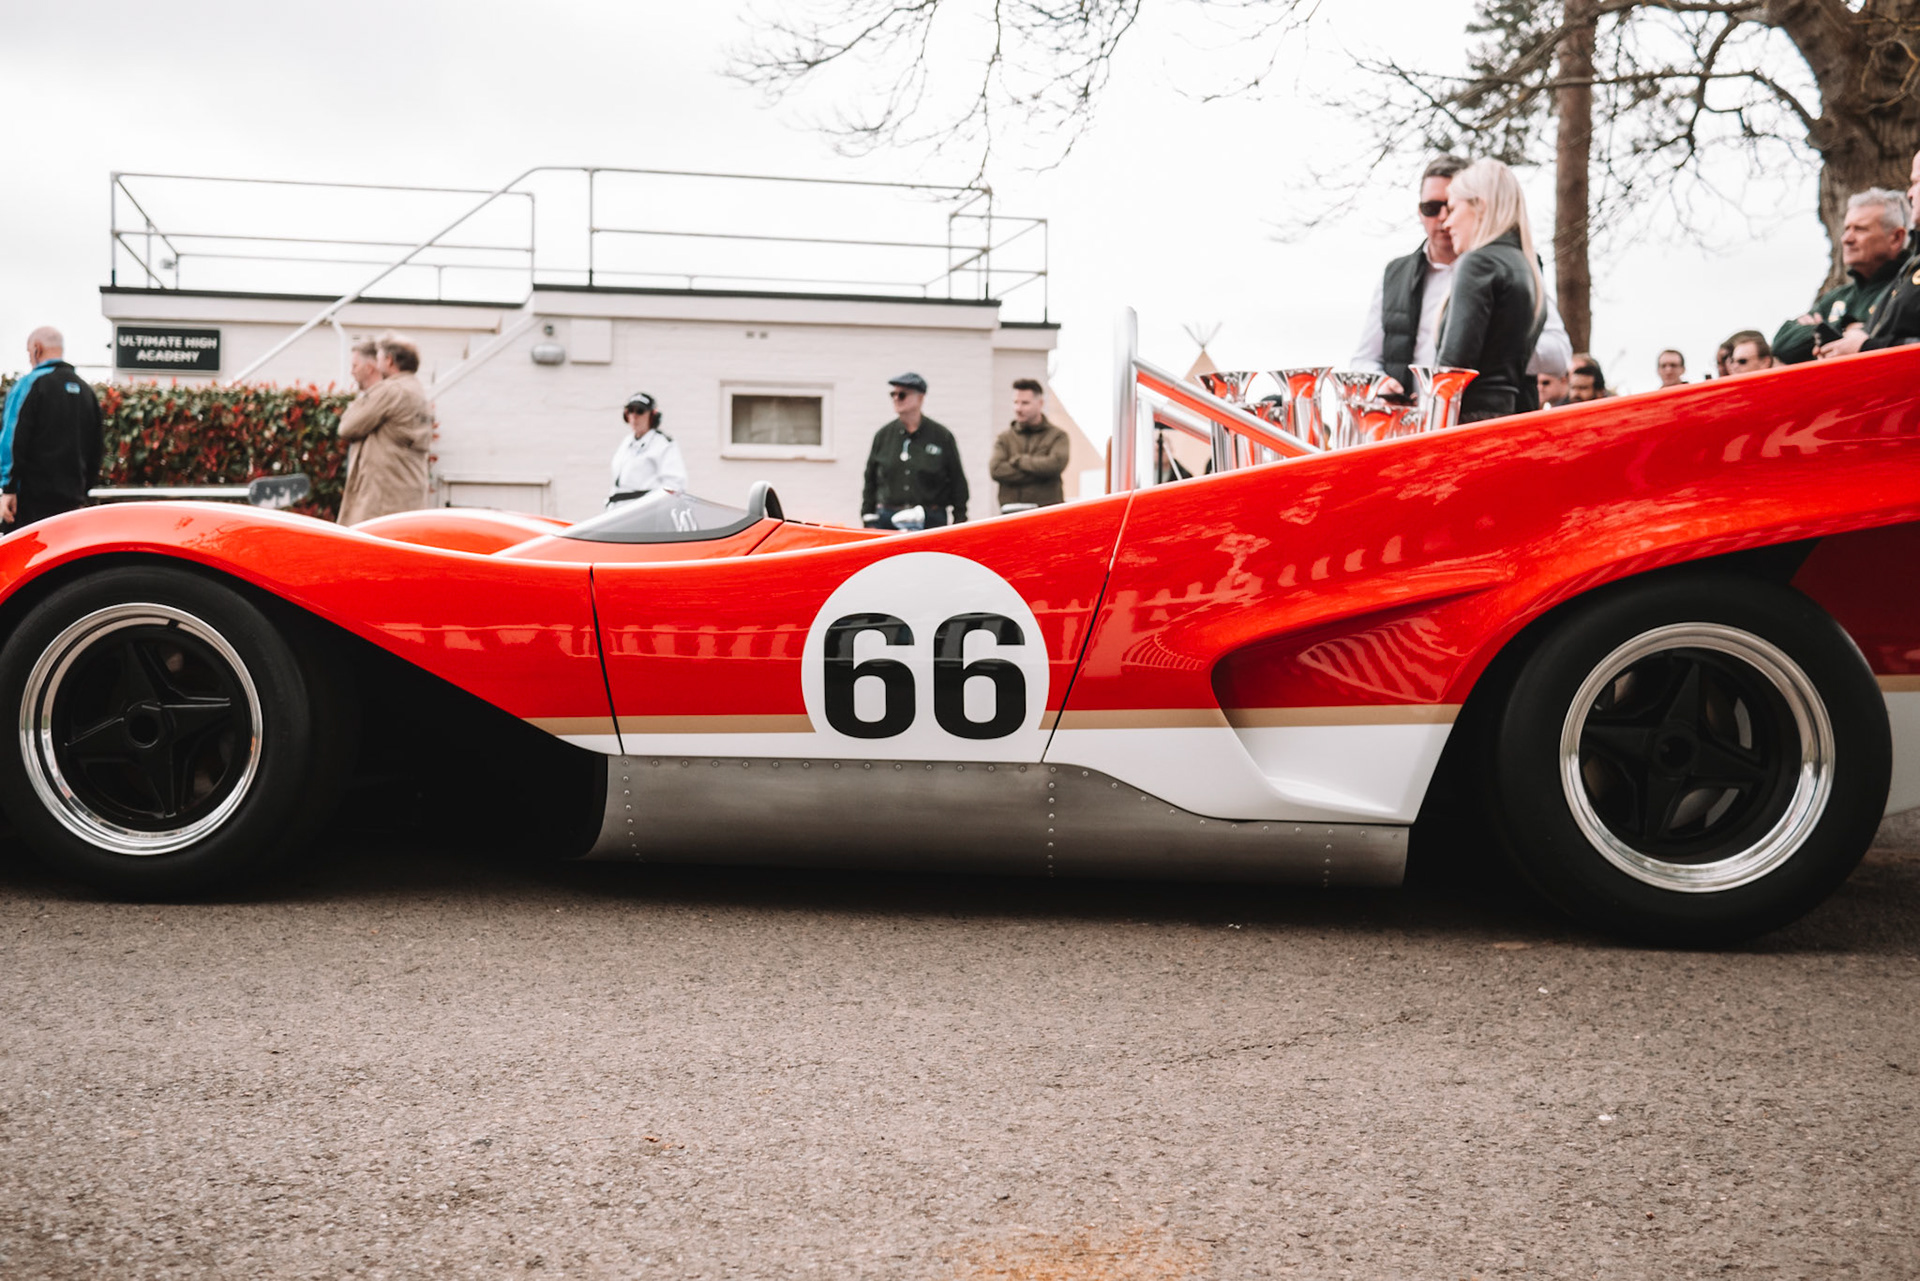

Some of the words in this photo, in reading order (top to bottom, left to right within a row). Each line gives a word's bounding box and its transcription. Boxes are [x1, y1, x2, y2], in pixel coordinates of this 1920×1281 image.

[119, 335, 183, 348] ULTIMATE
[185, 337, 217, 349] HIGH
[136, 350, 200, 362] ACADEMY
[824, 612, 1026, 740] 66
